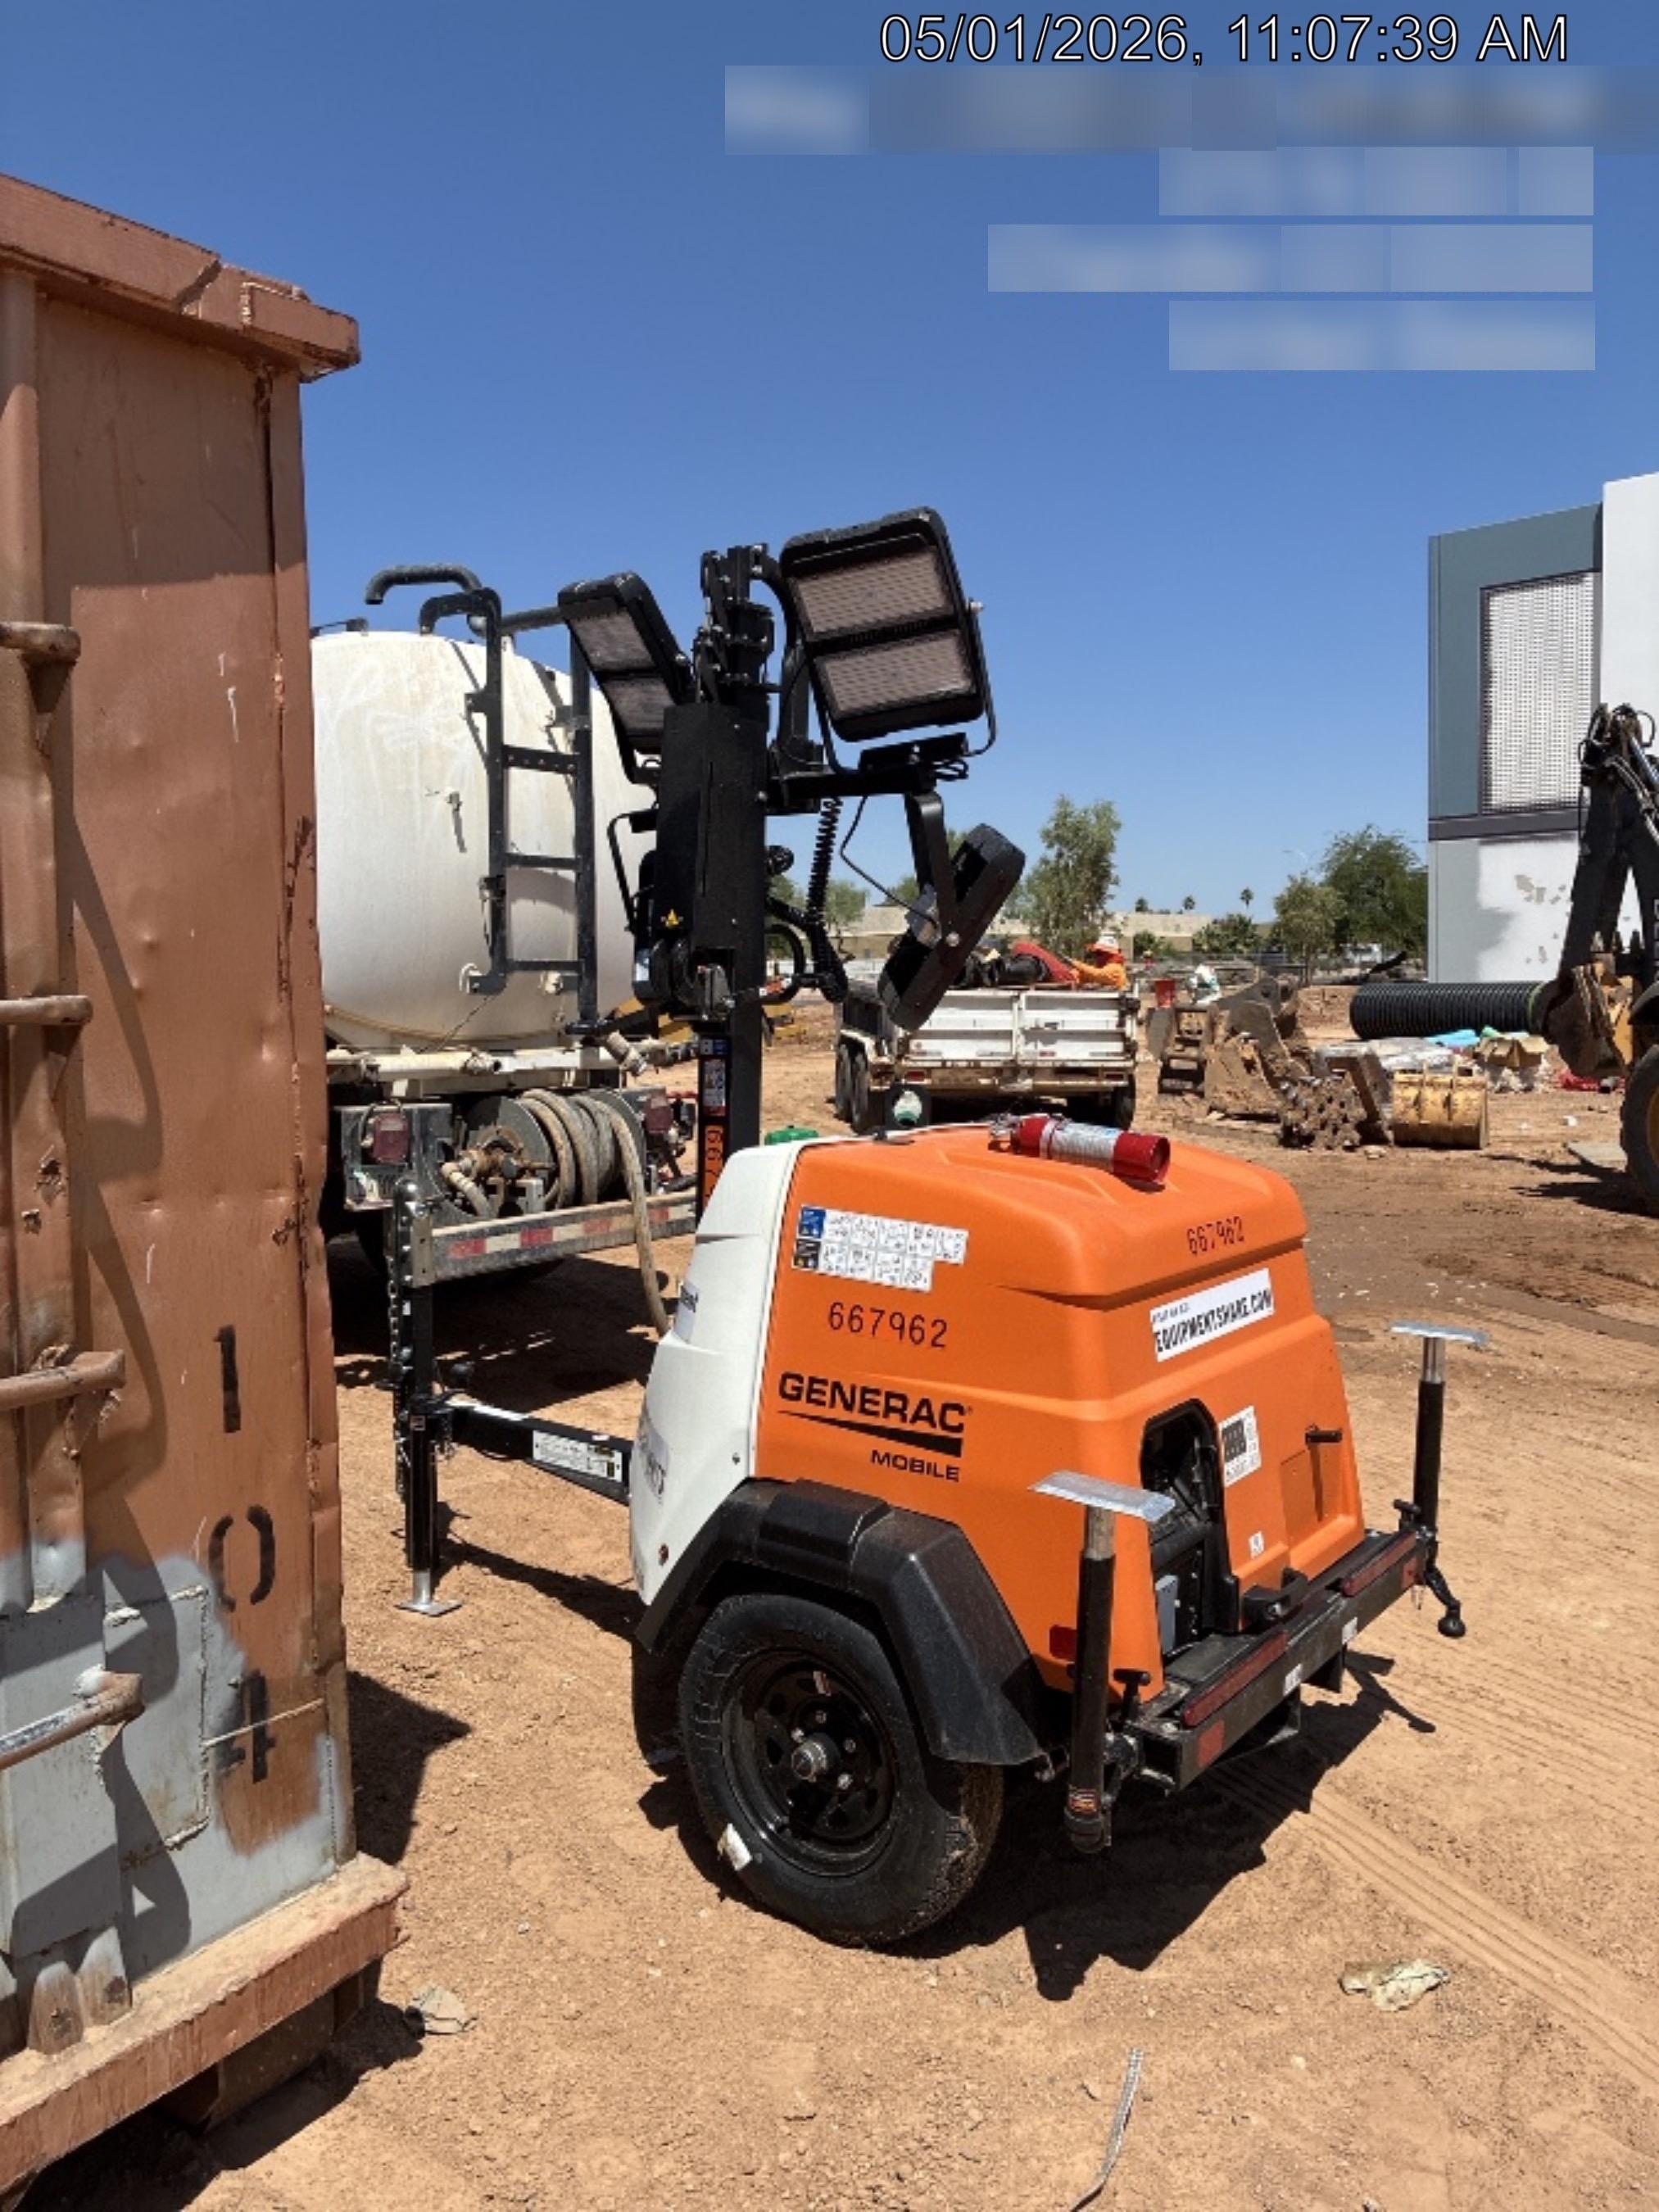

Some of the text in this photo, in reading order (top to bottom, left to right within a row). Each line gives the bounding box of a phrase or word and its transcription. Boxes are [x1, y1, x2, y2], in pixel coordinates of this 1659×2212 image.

[1187, 1216, 1244, 1254] 667962
[828, 1302, 948, 1348] 667962
[778, 1371, 966, 1434] GENERAC
[871, 1449, 960, 1482] MOBILE
